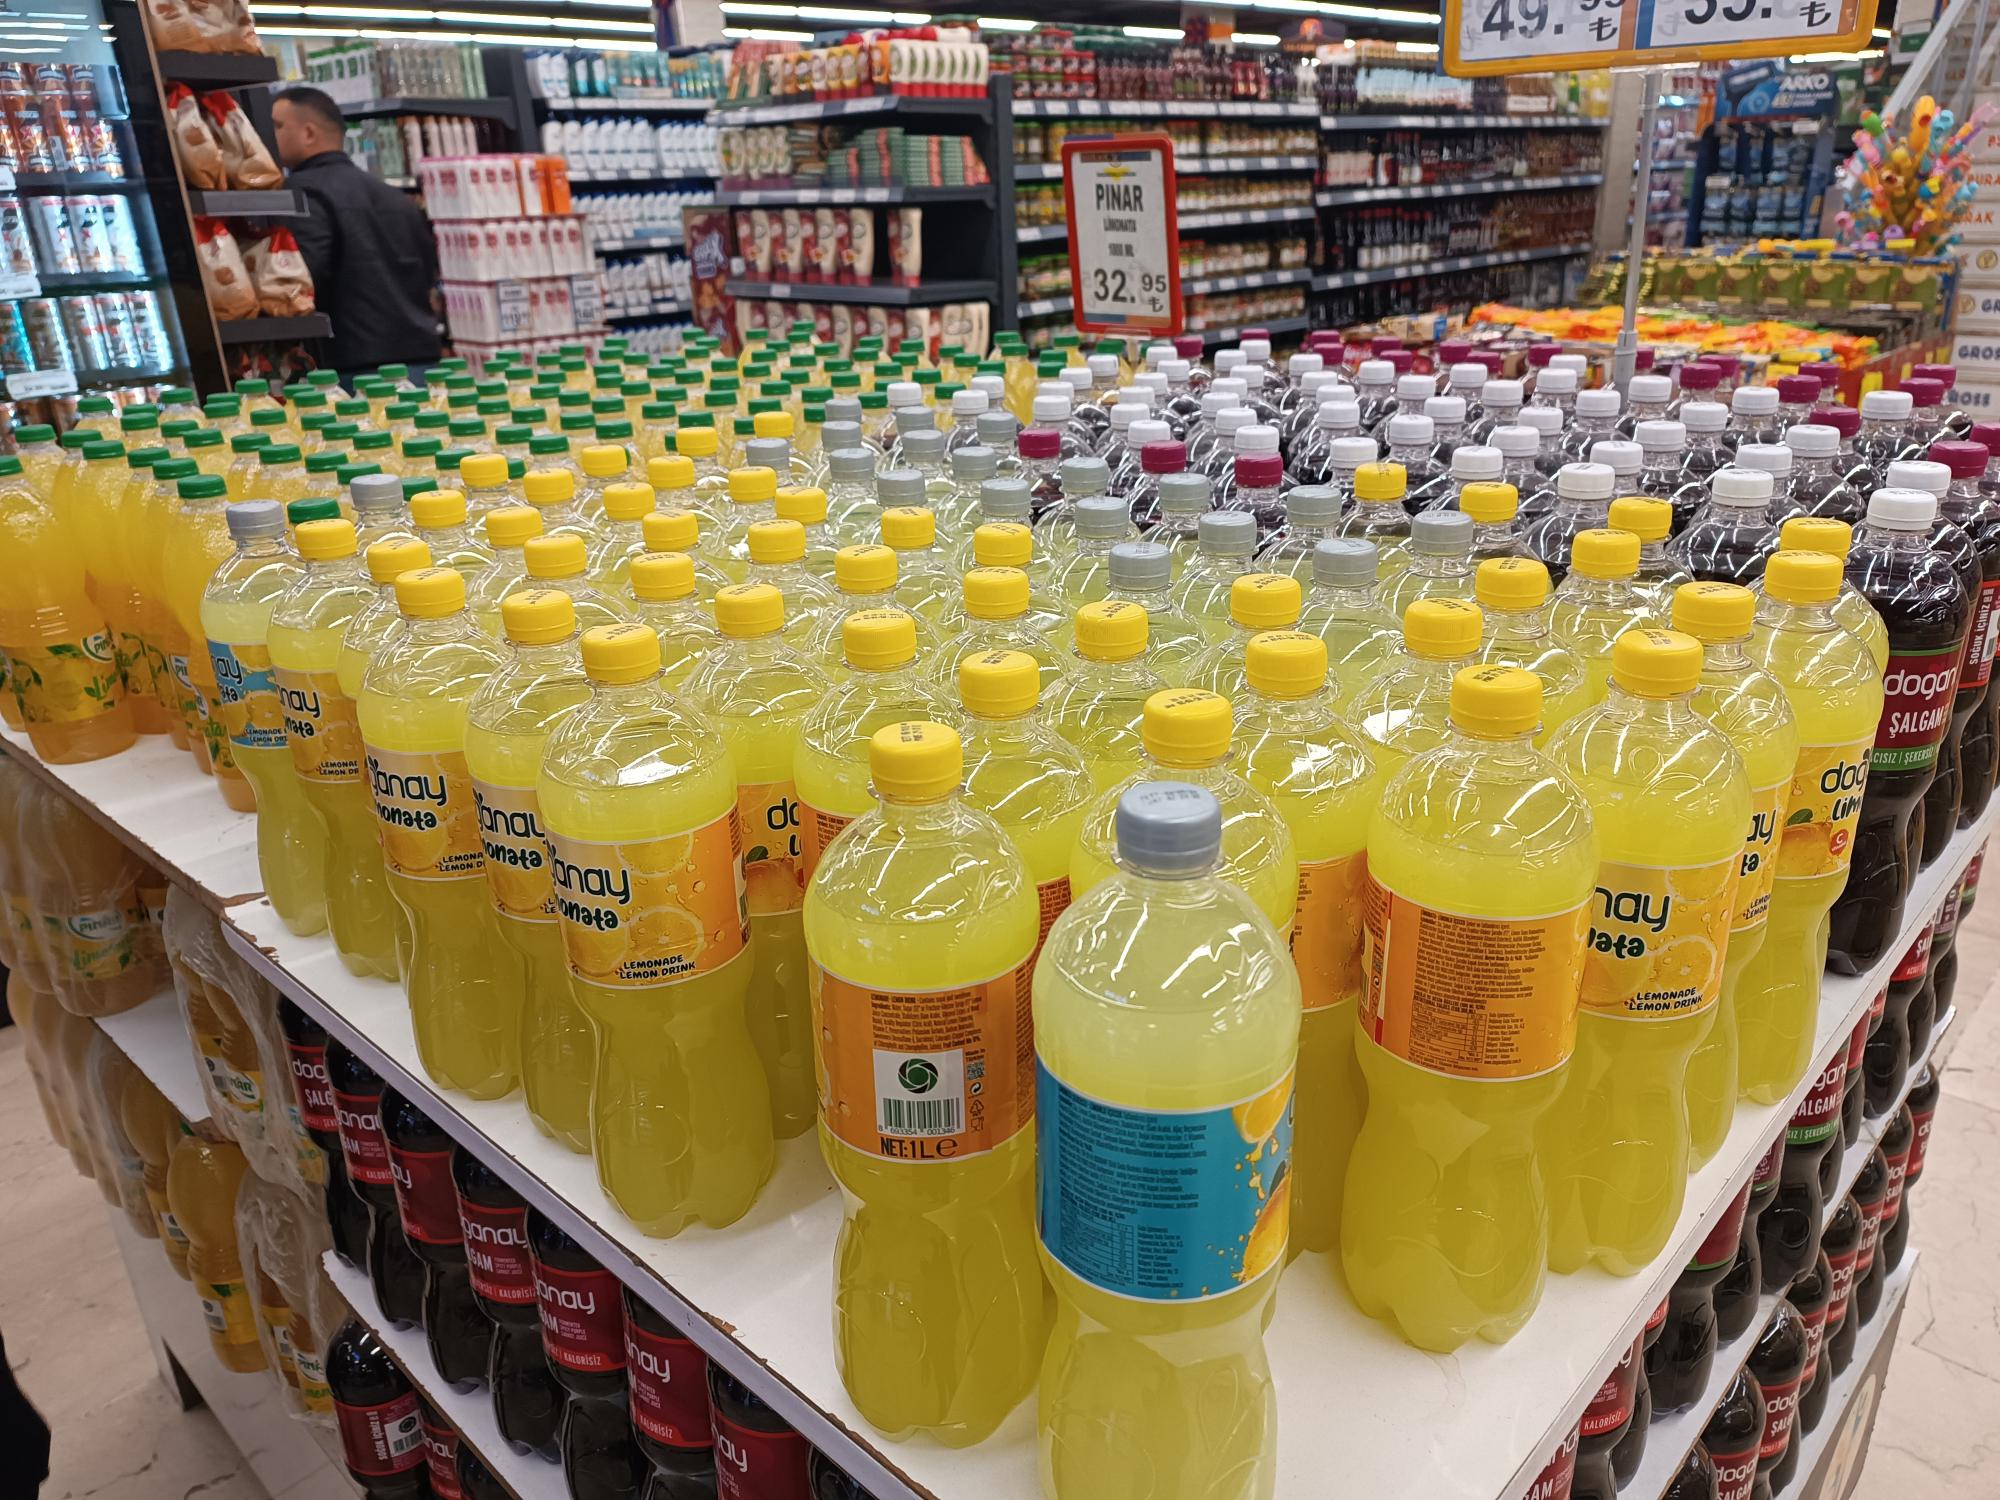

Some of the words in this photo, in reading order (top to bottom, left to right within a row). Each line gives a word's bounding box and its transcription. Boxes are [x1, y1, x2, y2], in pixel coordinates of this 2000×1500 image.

[1095, 183, 1144, 213] PINAR
[1093, 268, 1136, 304] 32.
[1141, 273, 1167, 293] 95
[213, 656, 244, 686] ay
[1889, 707, 1943, 739] ŞALGAM
[1872, 752, 1897, 765] CISIZ
[439, 863, 473, 872] LEMON
[551, 858, 631, 905] anay
[619, 969, 658, 980] LEMON
[661, 962, 696, 976] DRINK
[624, 954, 684, 970] LEMONADE
[1636, 986, 1697, 1001] LEMONADE
[1628, 1000, 1671, 1012] LEMON
[1673, 994, 1704, 1010] DRINK
